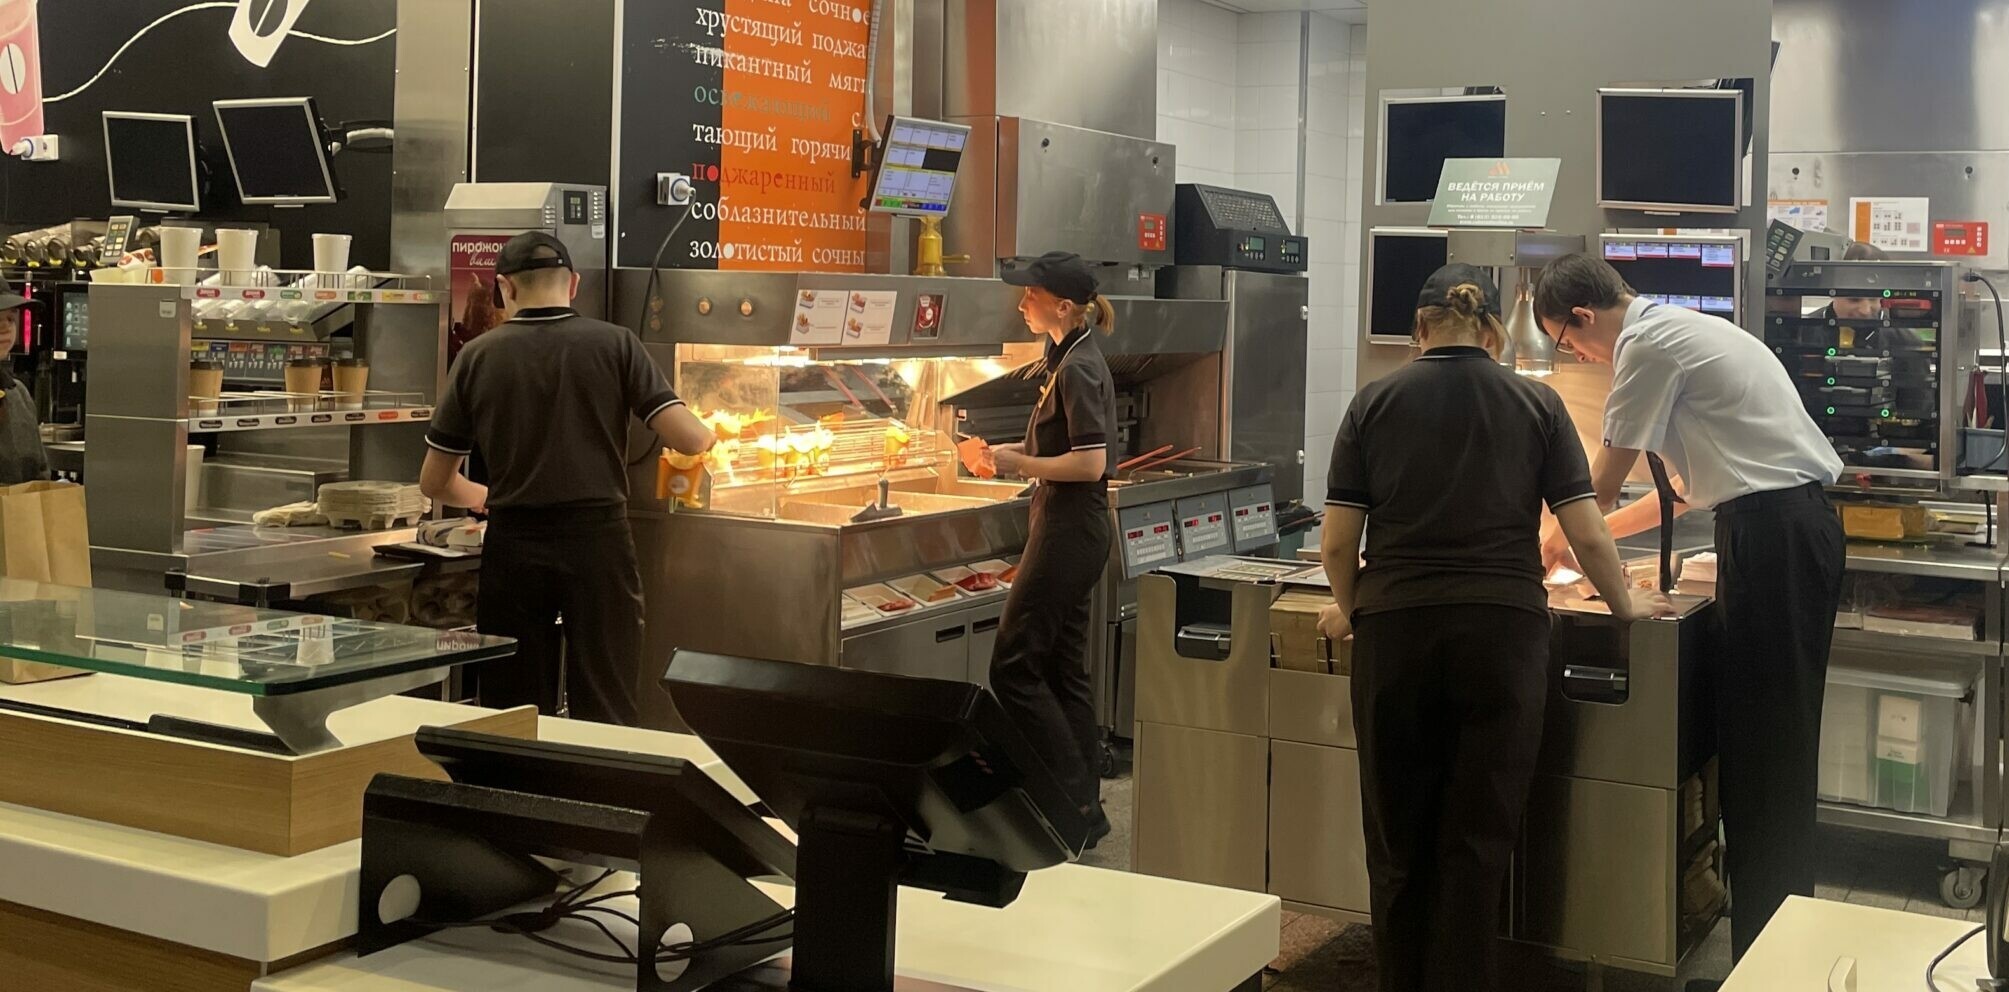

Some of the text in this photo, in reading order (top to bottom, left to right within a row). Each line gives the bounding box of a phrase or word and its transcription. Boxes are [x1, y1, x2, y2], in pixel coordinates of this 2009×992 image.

[695, 7, 803, 47] хрустящий
[694, 44, 812, 85] пикантный
[692, 123, 778, 154] тающий
[692, 163, 835, 194] поджаренный
[1447, 180, 1545, 192] ВЕДЁТСЯ ПРИЁМ
[1461, 192, 1525, 202] НА РАБОТУ
[691, 196, 866, 232] соблазнительный
[689, 238, 803, 263] золотистый
